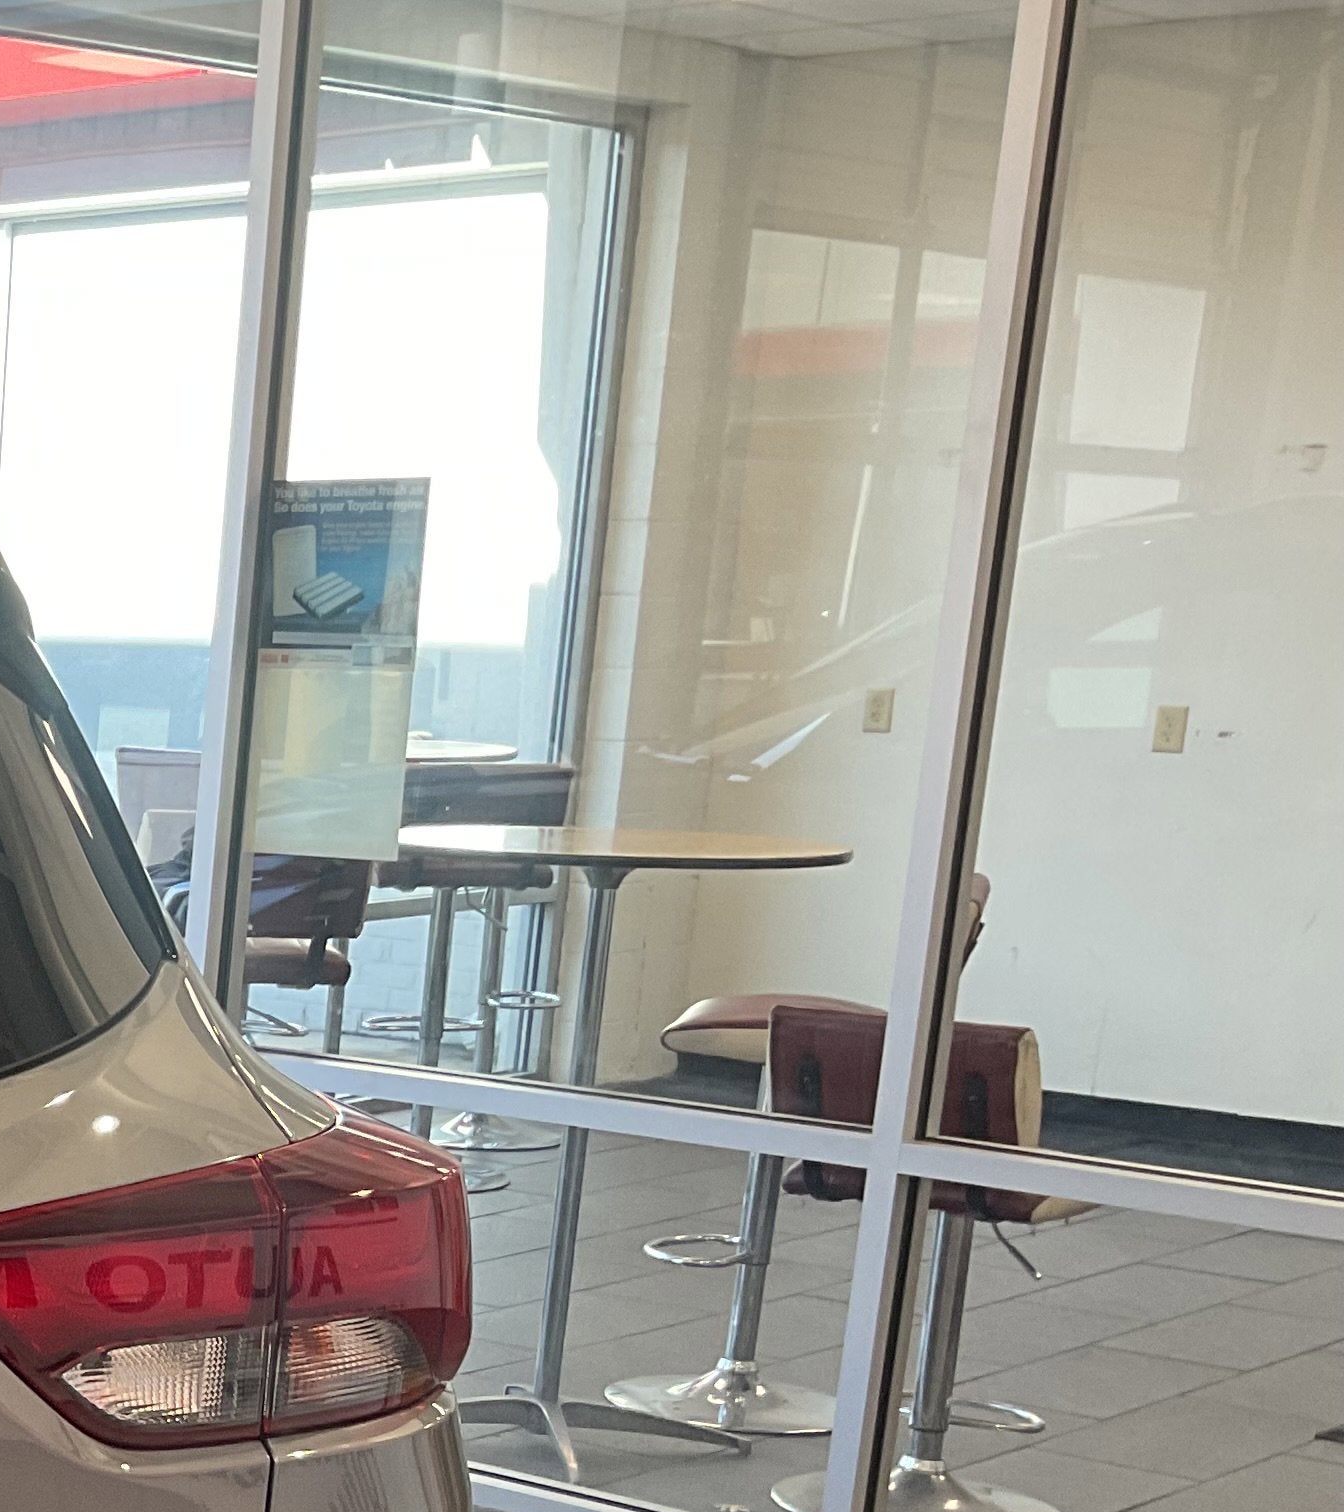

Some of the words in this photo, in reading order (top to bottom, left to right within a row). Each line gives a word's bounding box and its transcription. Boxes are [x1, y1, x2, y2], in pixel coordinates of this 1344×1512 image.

[275, 486, 295, 498] You
[319, 486, 330, 497] to
[332, 485, 376, 497] breathe
[273, 501, 289, 513] So
[290, 500, 318, 513] does
[320, 501, 345, 514] your
[347, 500, 384, 513] Toyota
